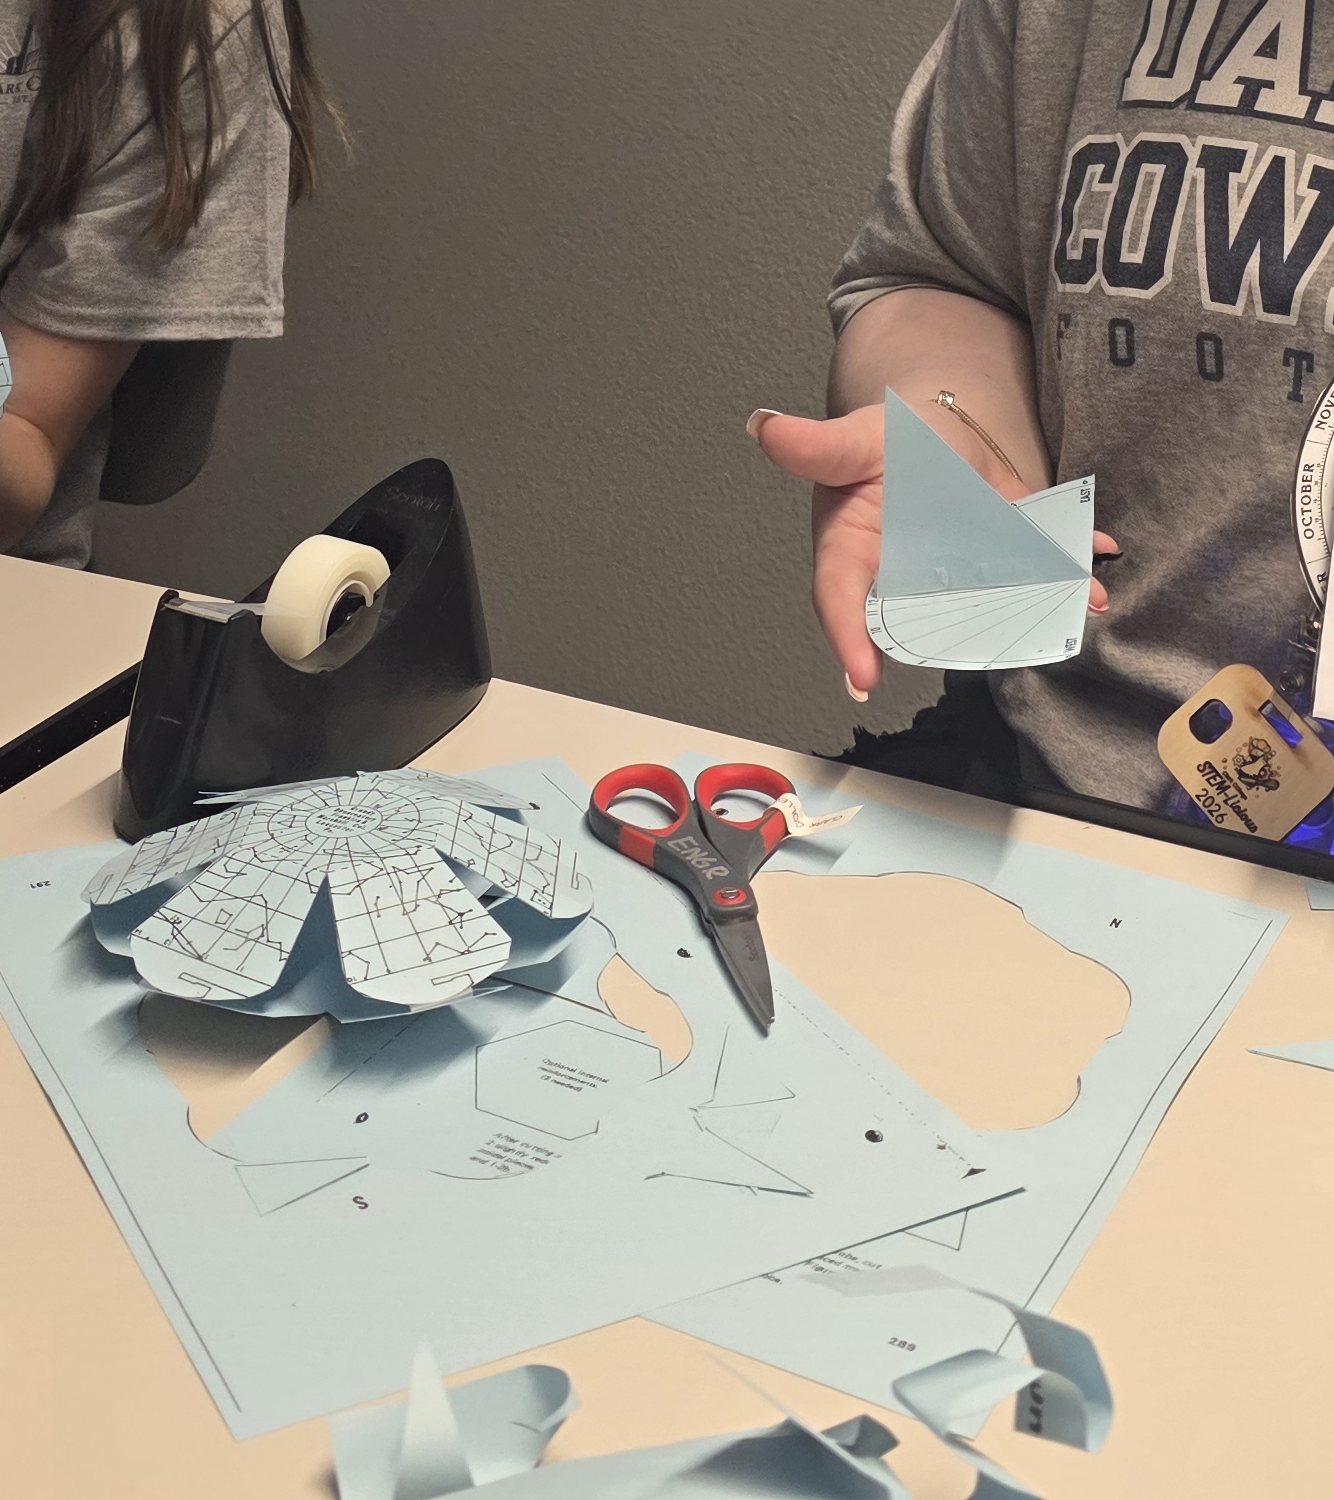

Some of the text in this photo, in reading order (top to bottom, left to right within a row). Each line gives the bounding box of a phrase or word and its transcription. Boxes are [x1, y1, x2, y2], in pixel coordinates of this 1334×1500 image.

[1080, 488, 1091, 504] EAST
[1301, 462, 1316, 541] OCTOBER
[1195, 788, 1227, 824] 2026
[1197, 761, 1257, 837] STEM-Licious
[667, 835, 731, 881] ENGR
[1109, 916, 1123, 930] N
[541, 1058, 610, 1084] Optional internal
[352, 1195, 369, 1210] S
[887, 1336, 917, 1353] 289
